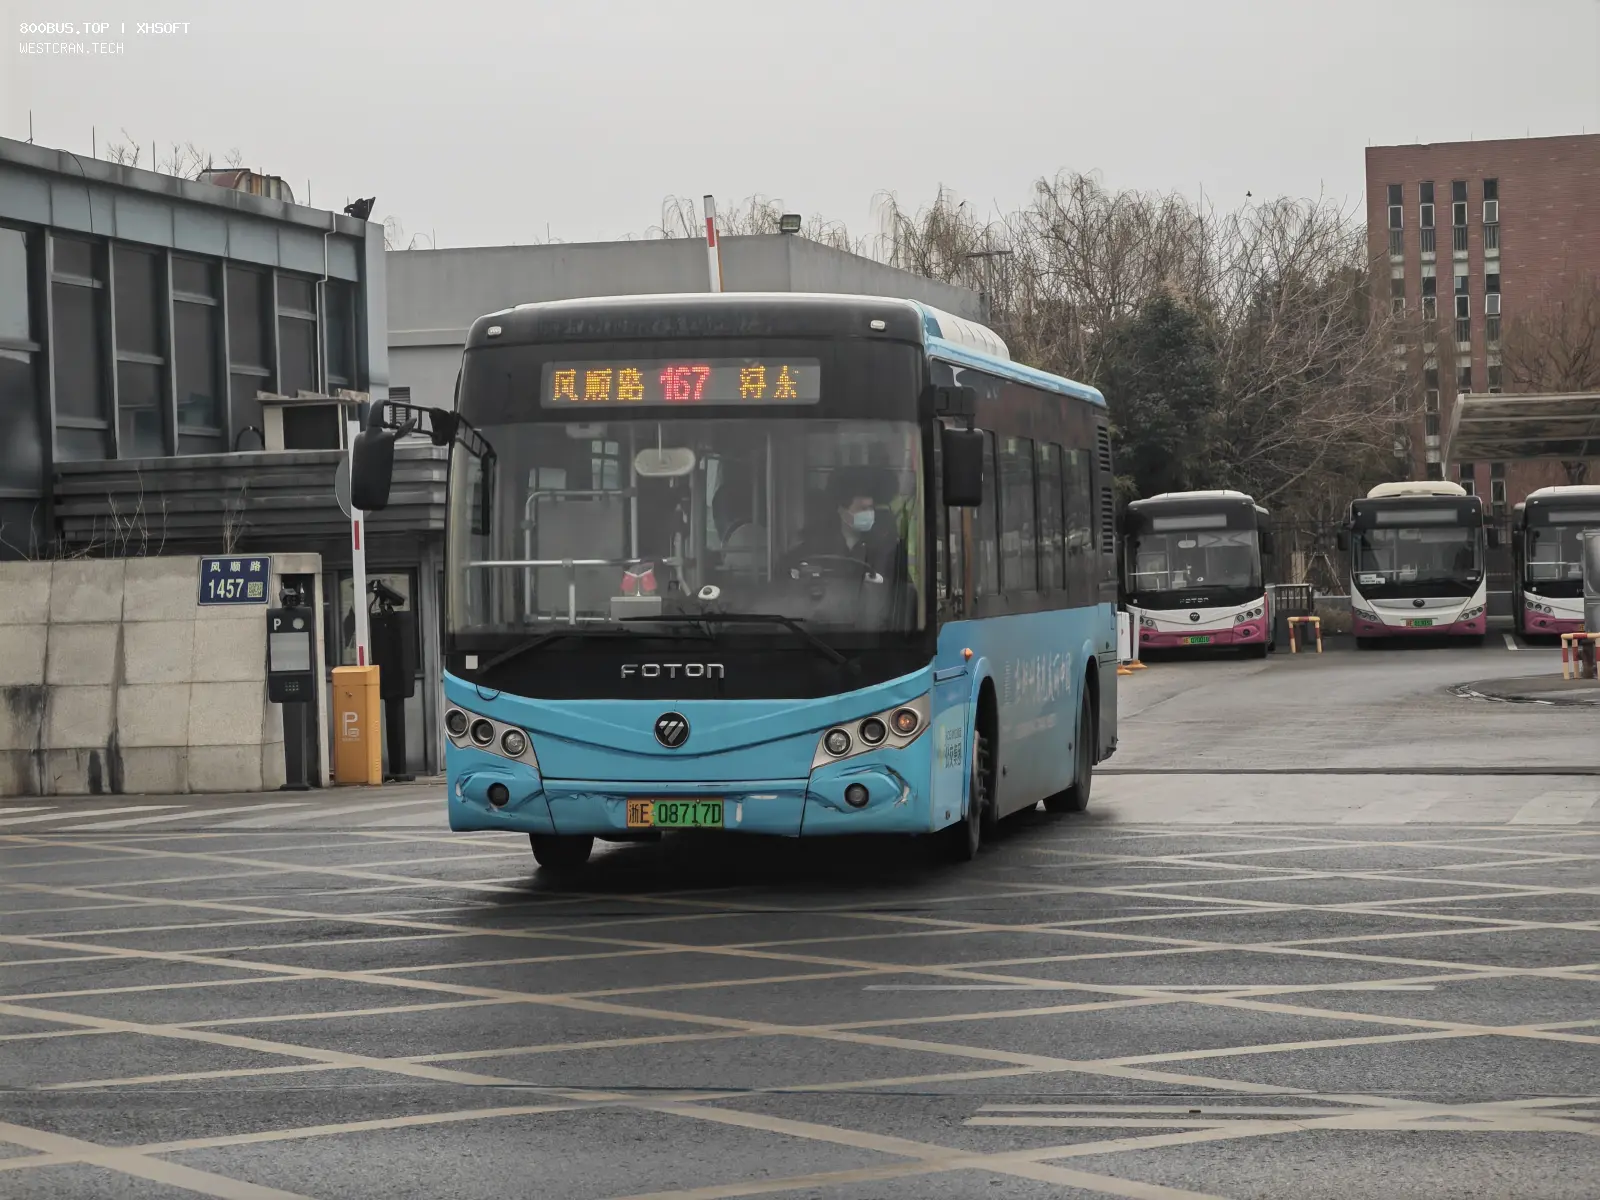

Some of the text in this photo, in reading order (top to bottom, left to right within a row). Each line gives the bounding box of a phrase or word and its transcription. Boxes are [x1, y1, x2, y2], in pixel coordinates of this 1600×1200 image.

[552, 367, 645, 401] 风顺路
[659, 365, 711, 400] 167
[210, 560, 261, 573] 风顺路
[208, 578, 245, 599] 1457
[273, 618, 282, 631] P
[620, 663, 725, 679] FOTON
[657, 800, 722, 824] 08717D
